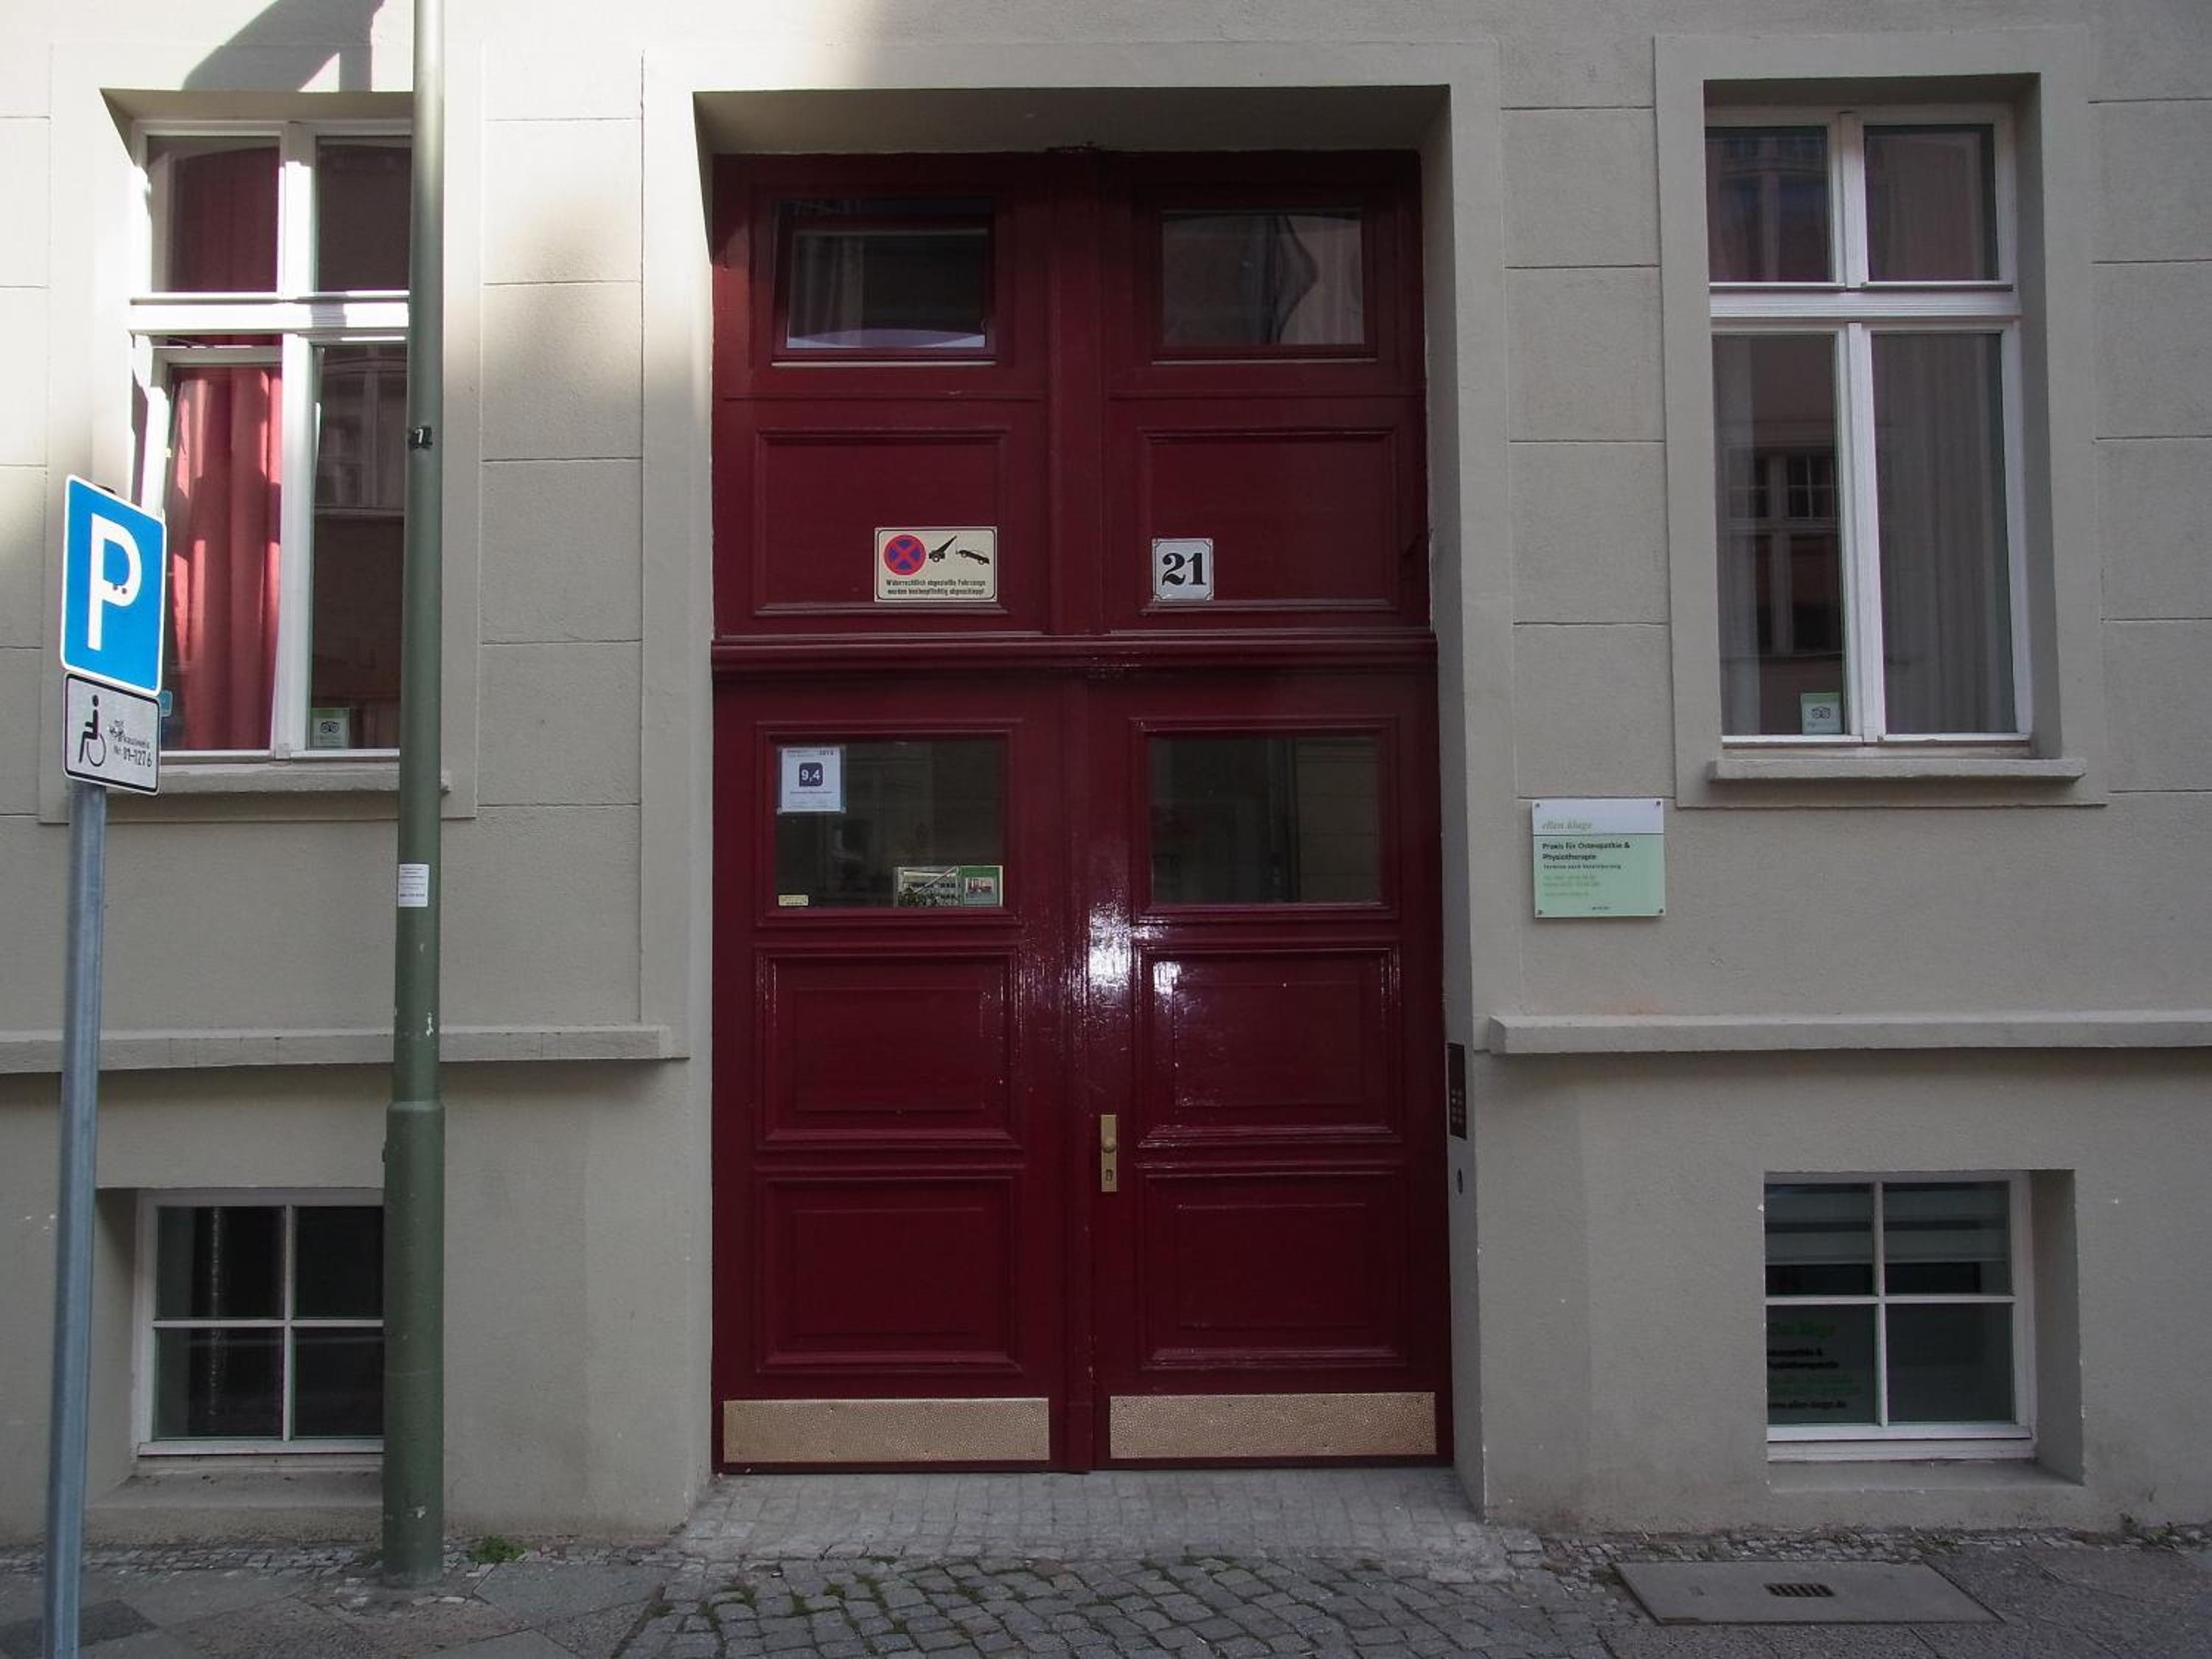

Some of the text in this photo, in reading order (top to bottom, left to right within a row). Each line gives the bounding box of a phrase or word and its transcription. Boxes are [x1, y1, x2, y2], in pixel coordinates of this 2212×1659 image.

[1161, 552, 1207, 586] 21
[88, 512, 142, 651] P
[801, 769, 821, 782] 9,4
[1542, 853, 1596, 862] Physiotherapie
